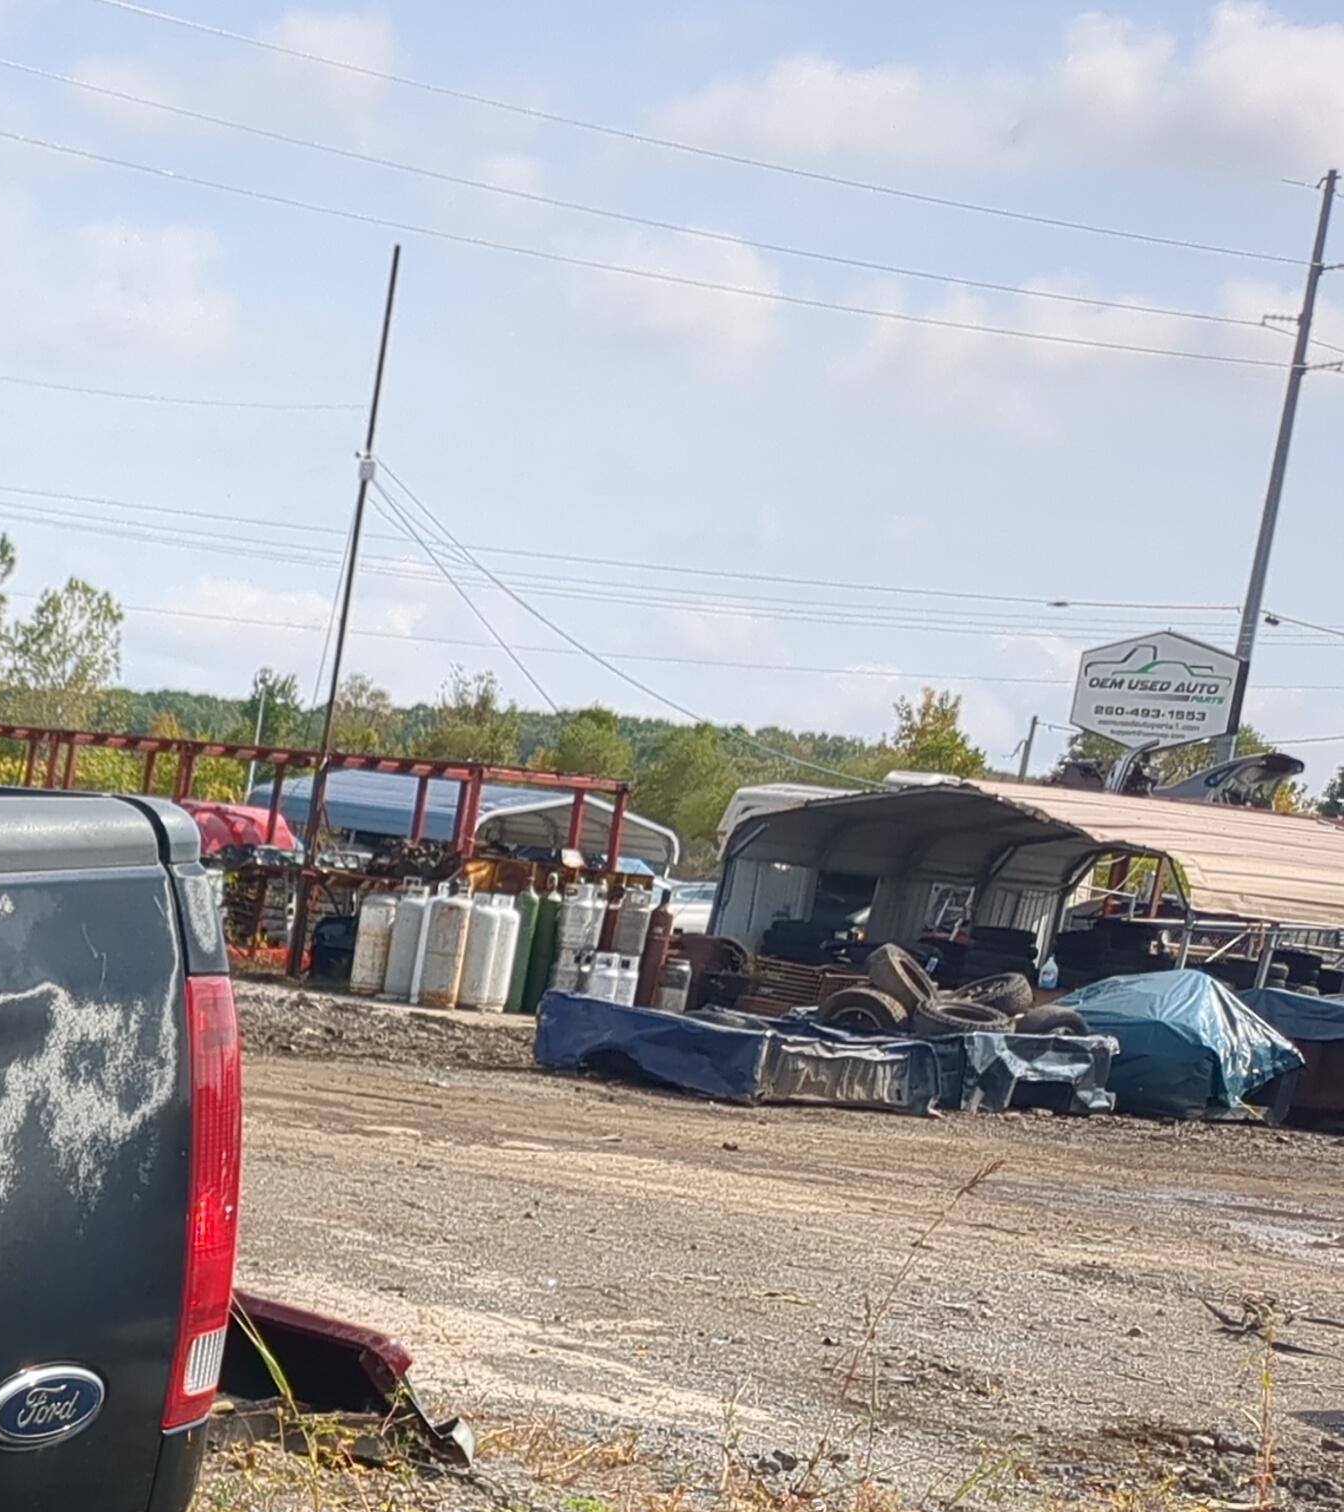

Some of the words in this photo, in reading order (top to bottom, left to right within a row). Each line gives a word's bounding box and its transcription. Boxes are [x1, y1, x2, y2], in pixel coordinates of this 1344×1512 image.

[1088, 677, 1124, 690] OEM
[1127, 679, 1172, 692] USED
[1173, 681, 1220, 695] AUTO
[1190, 695, 1226, 705] PARTS
[17, 1384, 80, 1428] Ford
